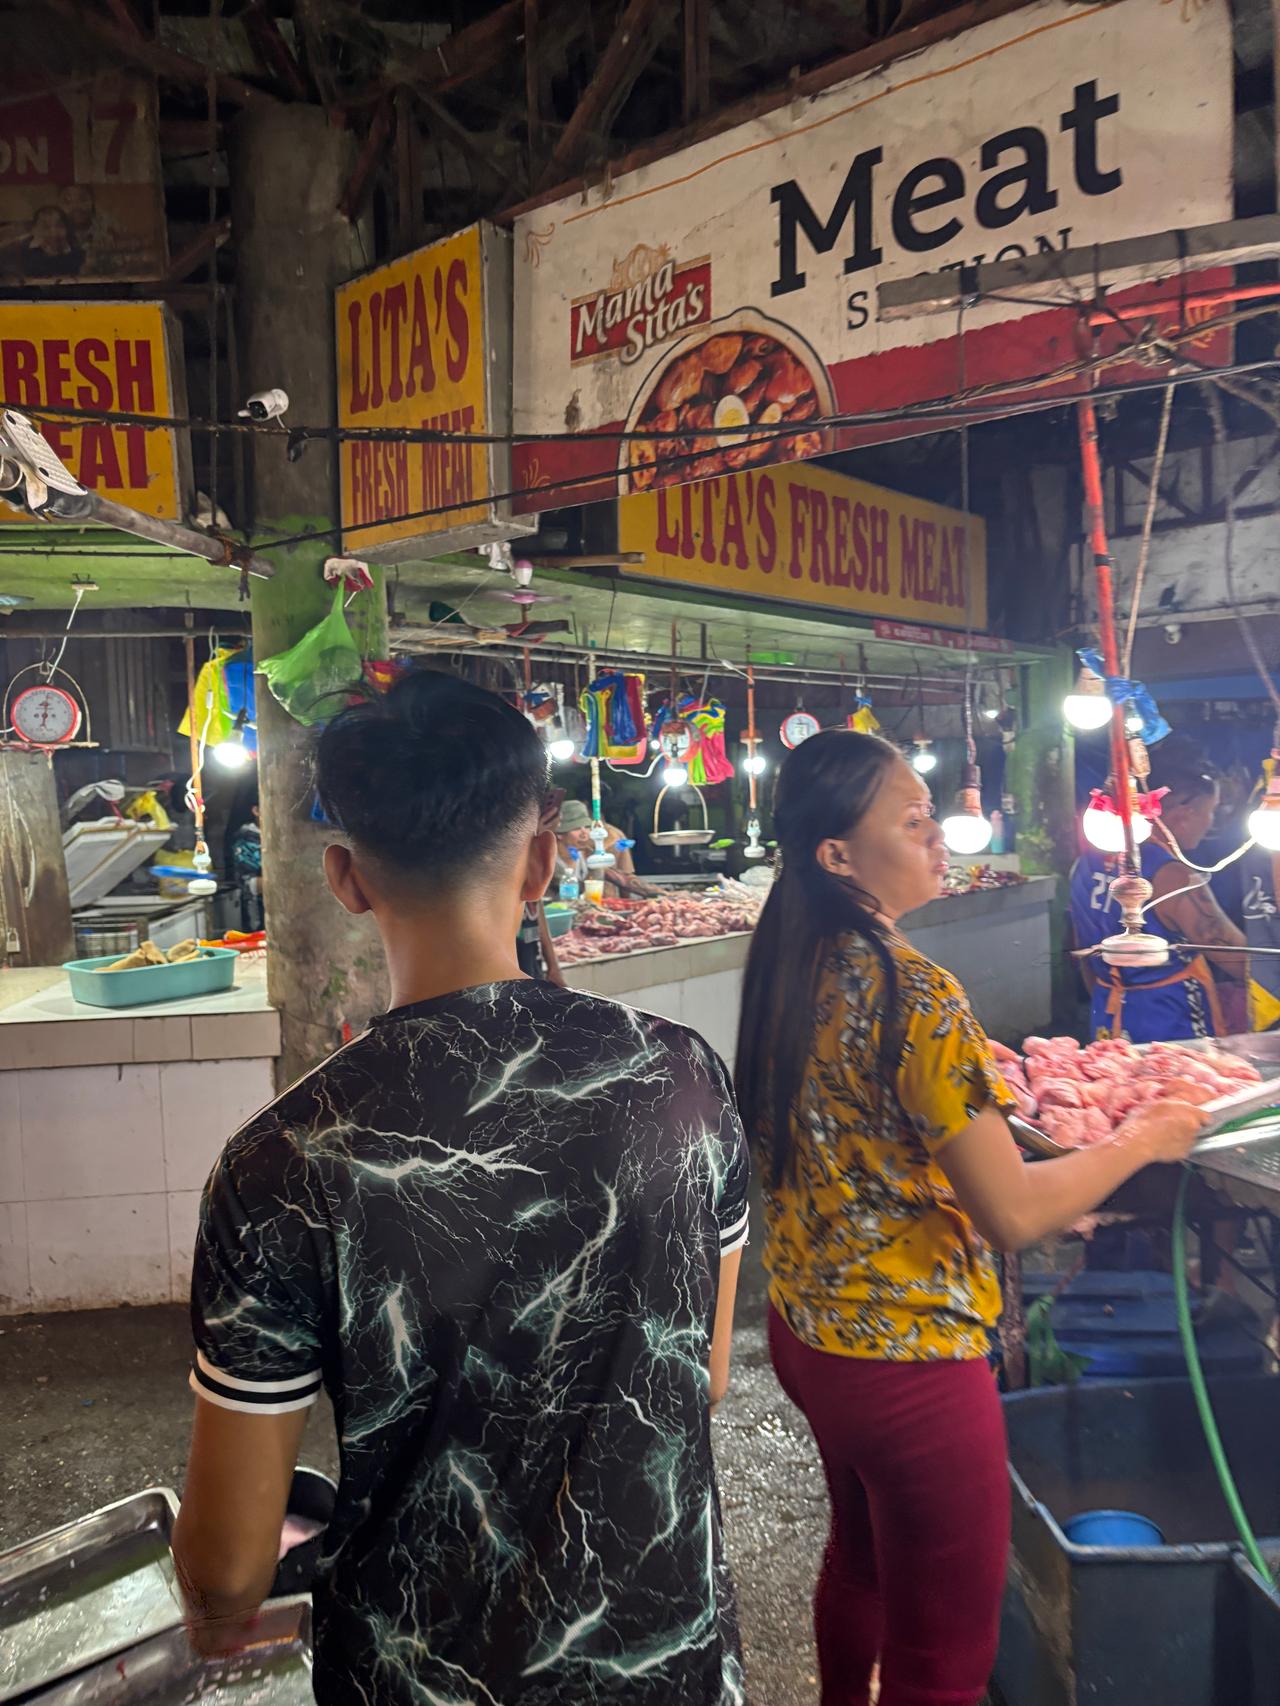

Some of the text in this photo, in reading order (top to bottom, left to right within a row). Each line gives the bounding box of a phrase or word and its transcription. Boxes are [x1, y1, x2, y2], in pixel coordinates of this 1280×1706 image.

[770, 78, 1123, 298] Meat
[348, 258, 469, 415] LITA'S
[575, 259, 674, 354] Mama
[619, 283, 705, 364] Sita's
[40, 422, 149, 489] EAT
[351, 405, 474, 525] FRESH MEAT
[655, 470, 966, 609] LITA'S FRESH MEAT
